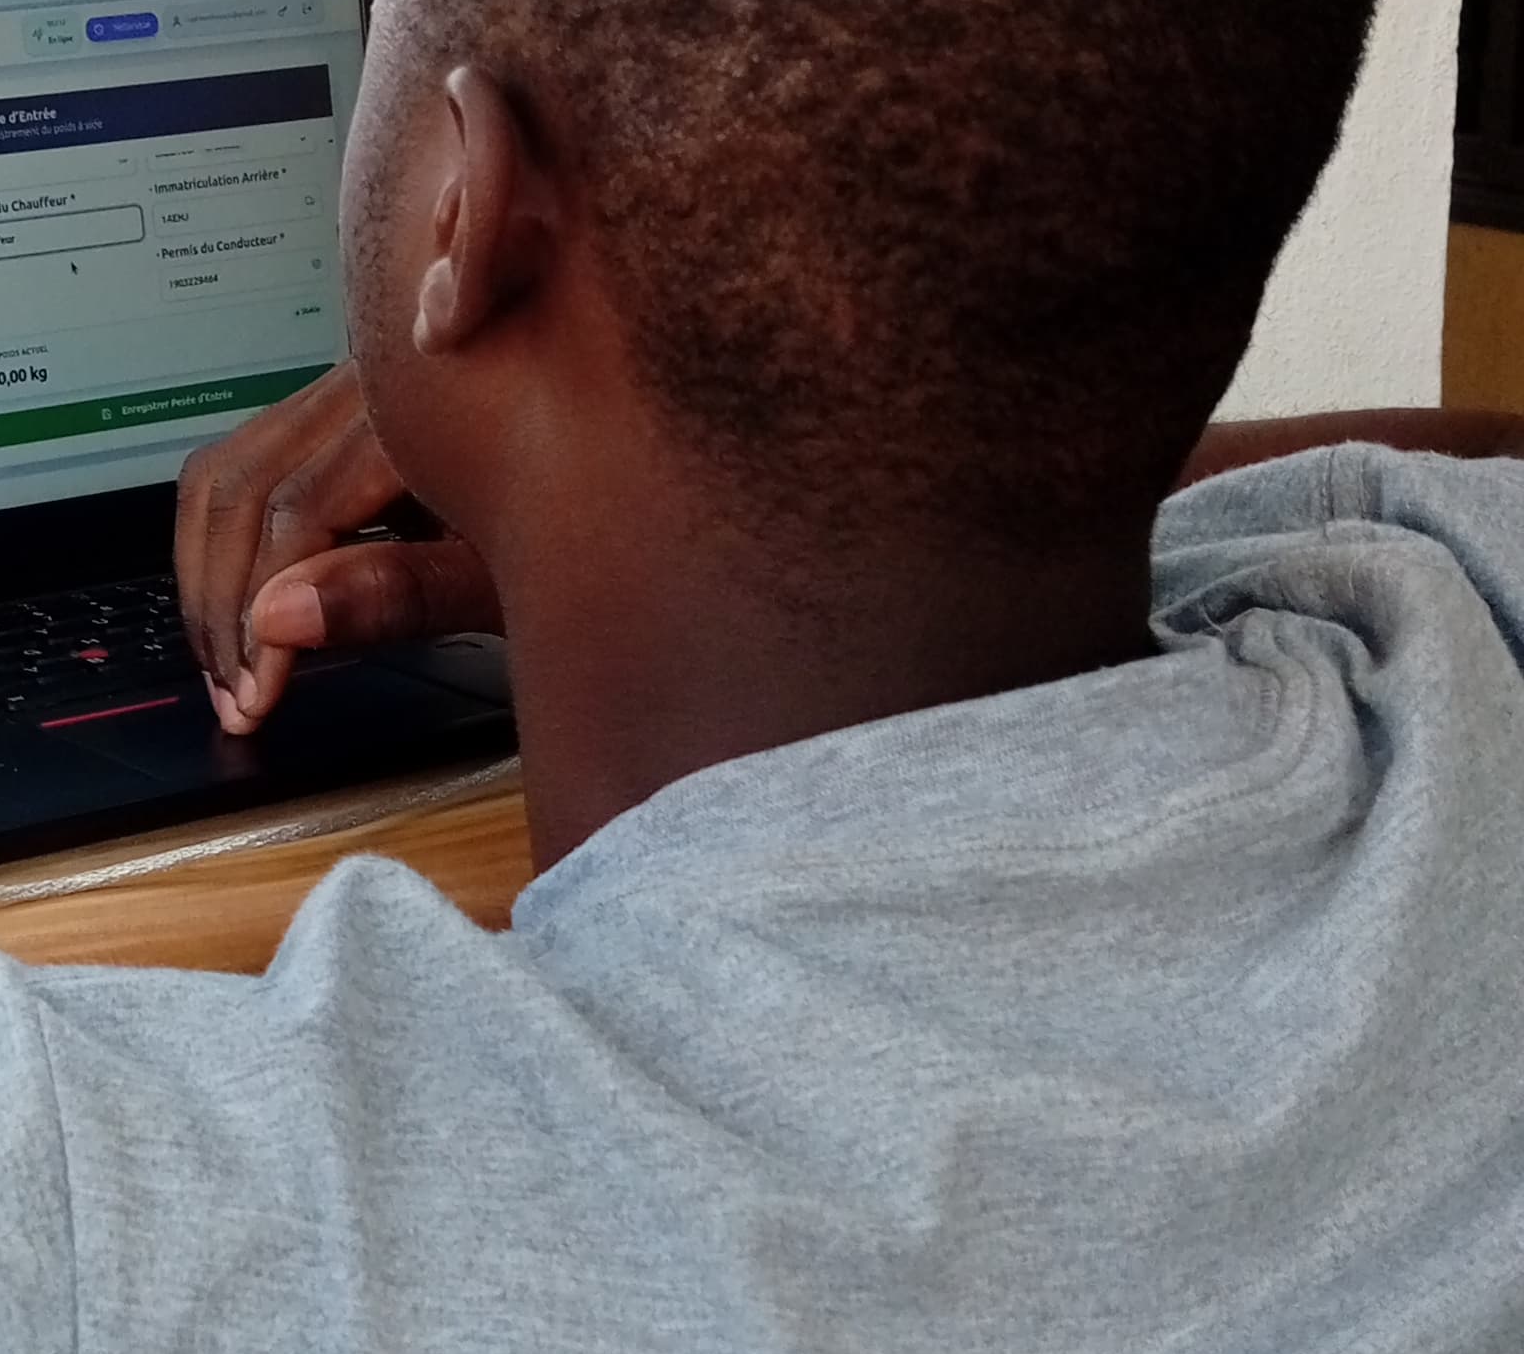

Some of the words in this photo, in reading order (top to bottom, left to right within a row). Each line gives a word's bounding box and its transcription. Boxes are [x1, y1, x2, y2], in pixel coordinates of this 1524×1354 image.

[8, 106, 58, 124] d'Entrée
[41, 124, 53, 136] du
[54, 122, 77, 136] poids
[154, 173, 241, 195] Immatriculation
[241, 167, 280, 185] Arrière
[11, 194, 68, 214] Chauffeur
[161, 245, 198, 261] Permis
[200, 241, 215, 255] du
[216, 233, 278, 253] Conducteur
[29, 364, 49, 384] kg
[121, 397, 170, 417] Enregistrer
[170, 394, 197, 408] Pesée
